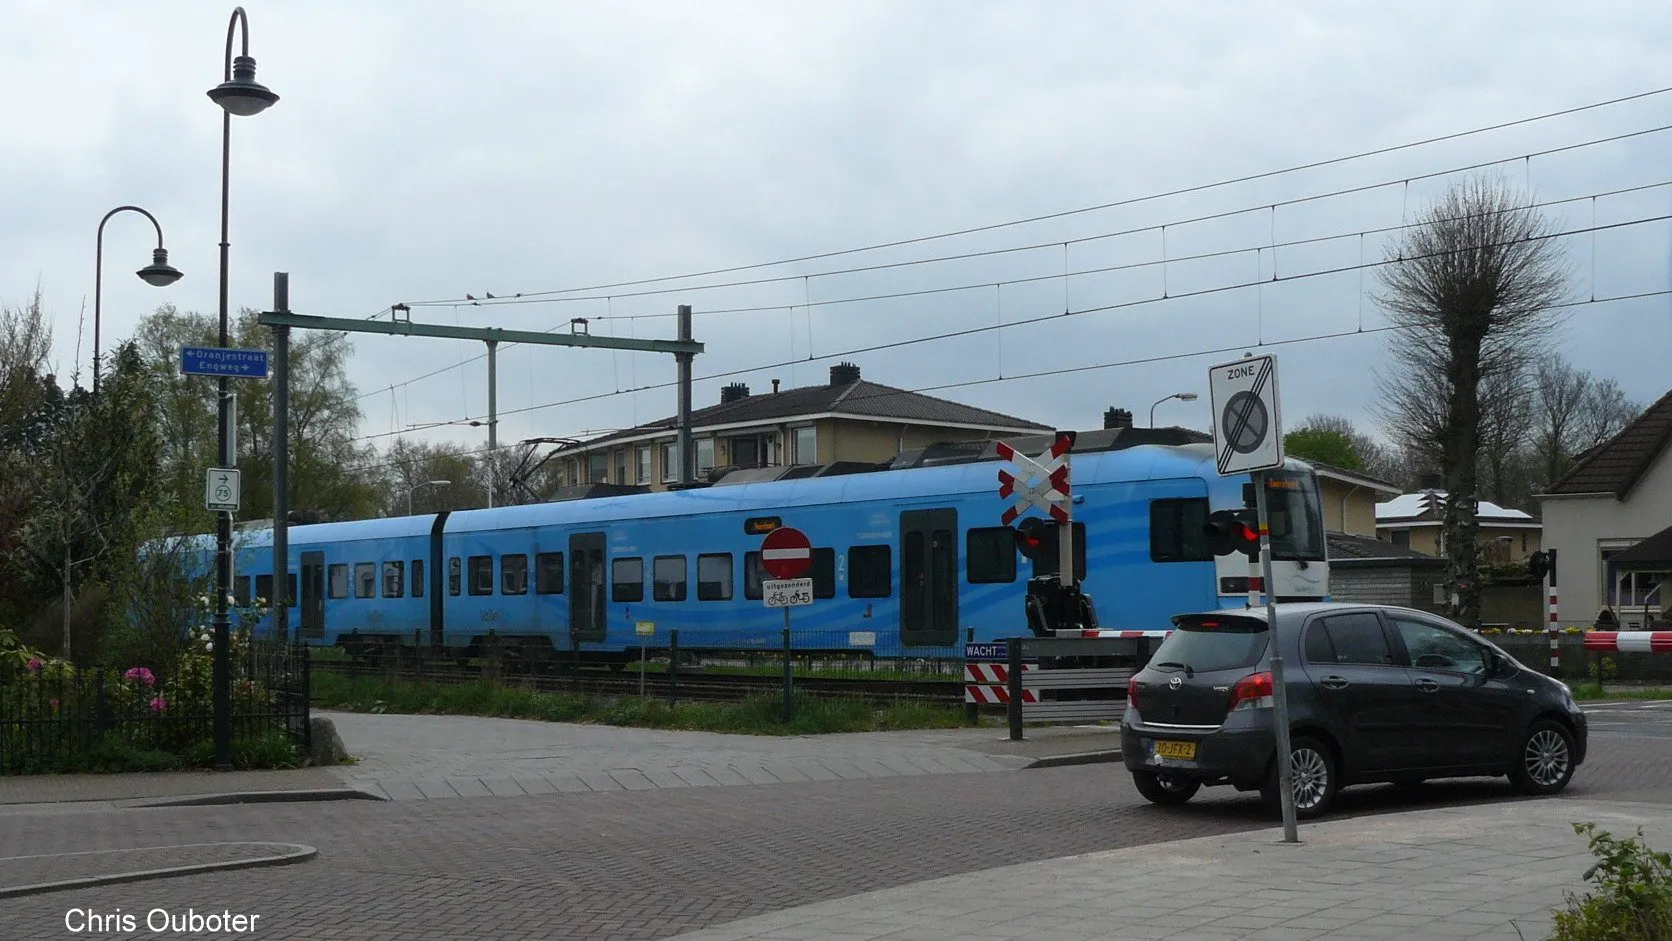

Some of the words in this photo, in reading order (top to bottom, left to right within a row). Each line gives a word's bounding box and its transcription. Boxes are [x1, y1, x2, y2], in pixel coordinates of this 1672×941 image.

[196, 350, 264, 362] Oranjestraat
[199, 361, 240, 373] Engweg
[1227, 365, 1255, 380] ZONE
[218, 489, 229, 497] 75
[766, 581, 811, 590] uitgezonderd
[966, 646, 997, 656] WACHT
